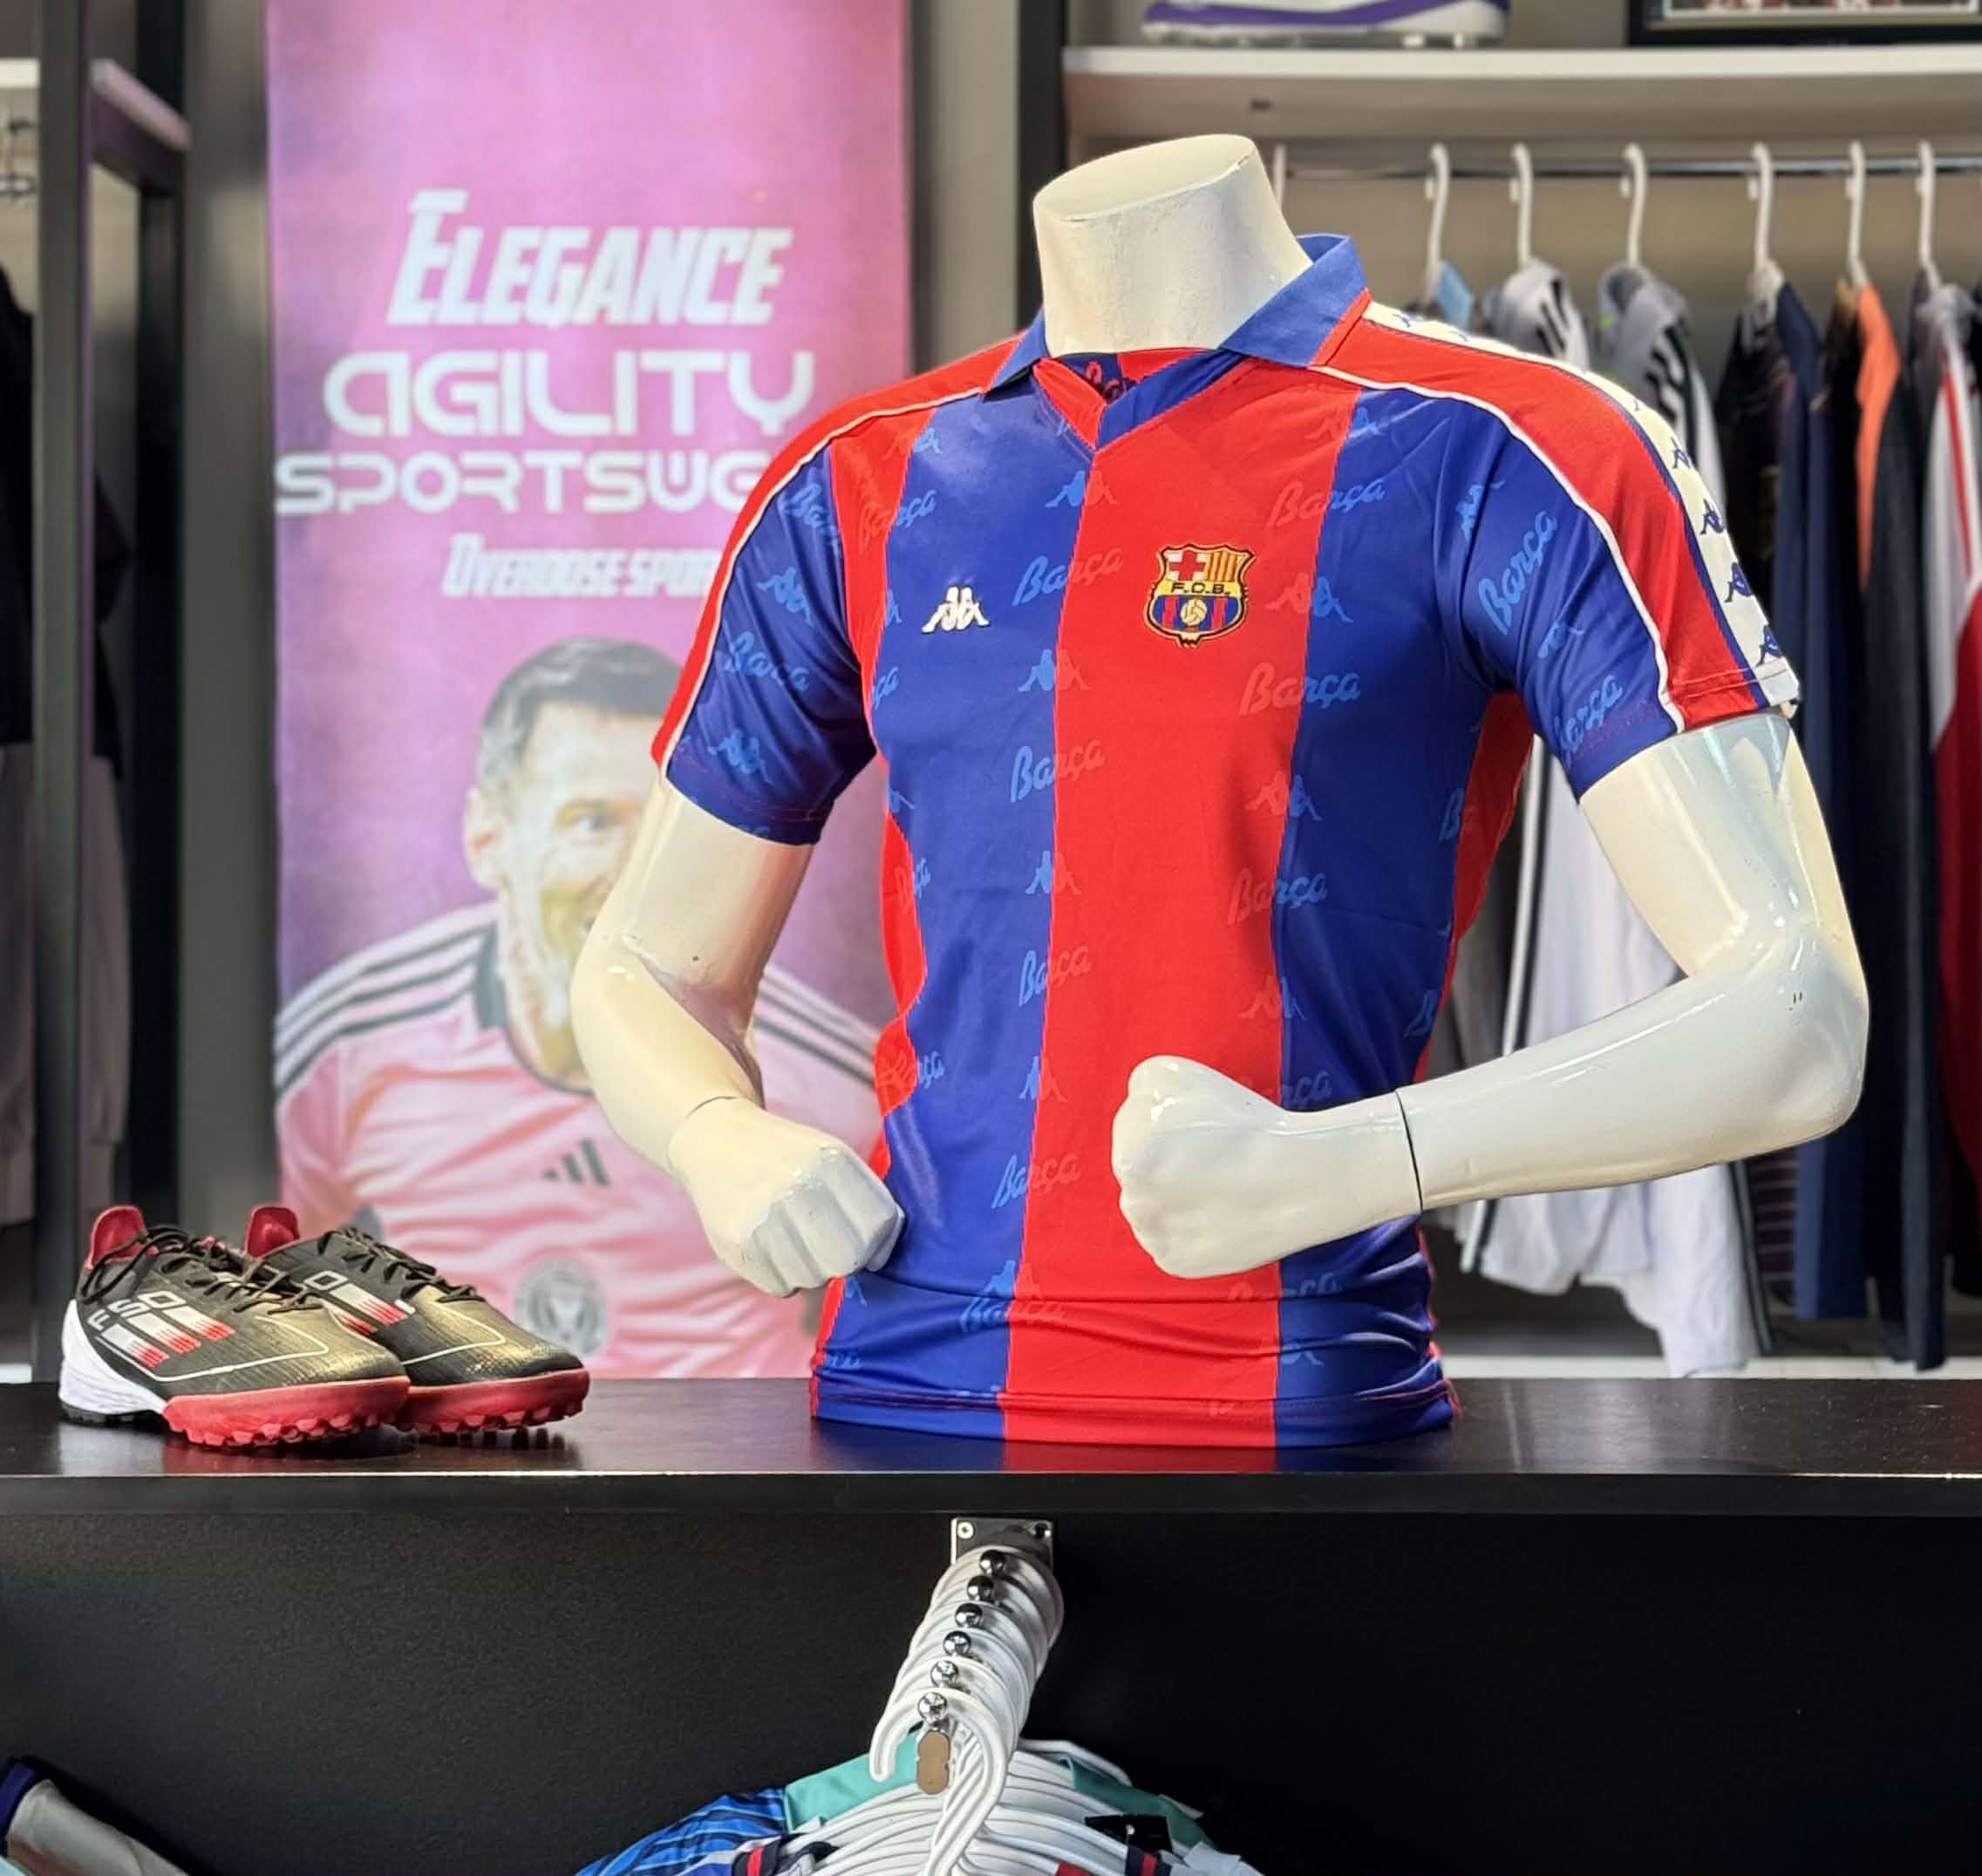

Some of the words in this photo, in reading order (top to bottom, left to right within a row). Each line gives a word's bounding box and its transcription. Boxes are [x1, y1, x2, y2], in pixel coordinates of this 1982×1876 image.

[386, 188, 792, 327] ELEGANCE
[323, 350, 814, 436] AGILITY
[1269, 480, 1385, 528] Barça
[1011, 549, 1122, 607] Barça
[1478, 511, 1557, 635] Barça
[1239, 663, 1360, 716] Barça
[1010, 740, 1104, 802] Barça
[1227, 869, 1328, 925] Barça
[1018, 946, 1093, 1006] Barça
[991, 1154, 1081, 1209] Barça
[87, 1290, 187, 1331] F50
